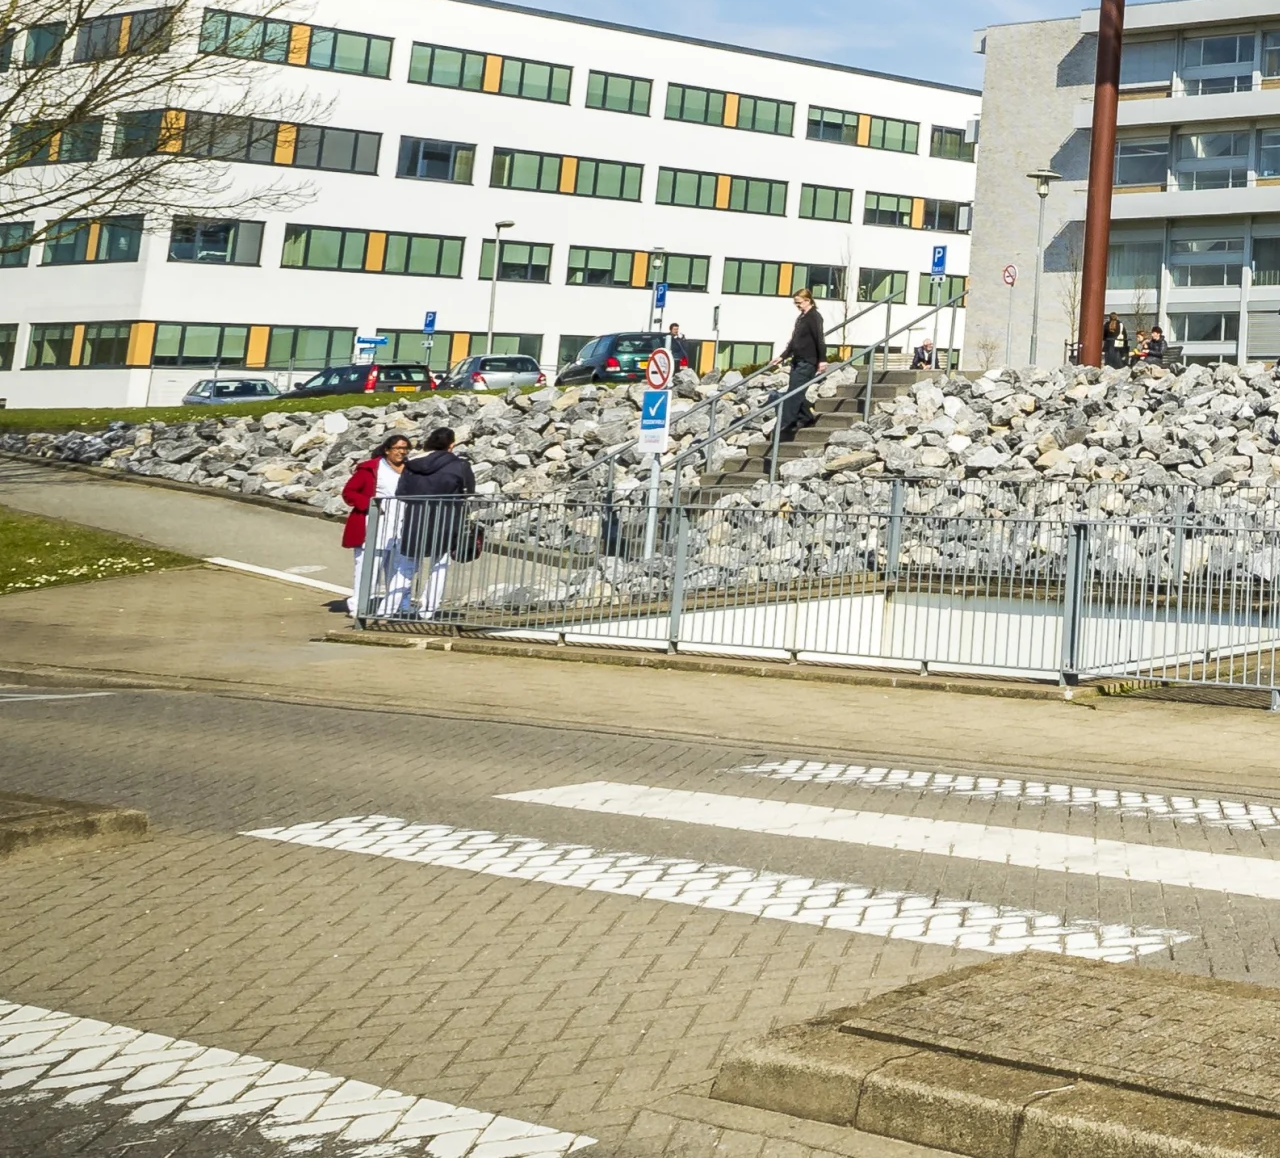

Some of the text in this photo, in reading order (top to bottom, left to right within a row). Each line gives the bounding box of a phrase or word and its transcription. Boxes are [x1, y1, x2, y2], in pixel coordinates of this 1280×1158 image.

[934, 248, 943, 263] P
[658, 286, 664, 299] P
[427, 313, 433, 324] P
